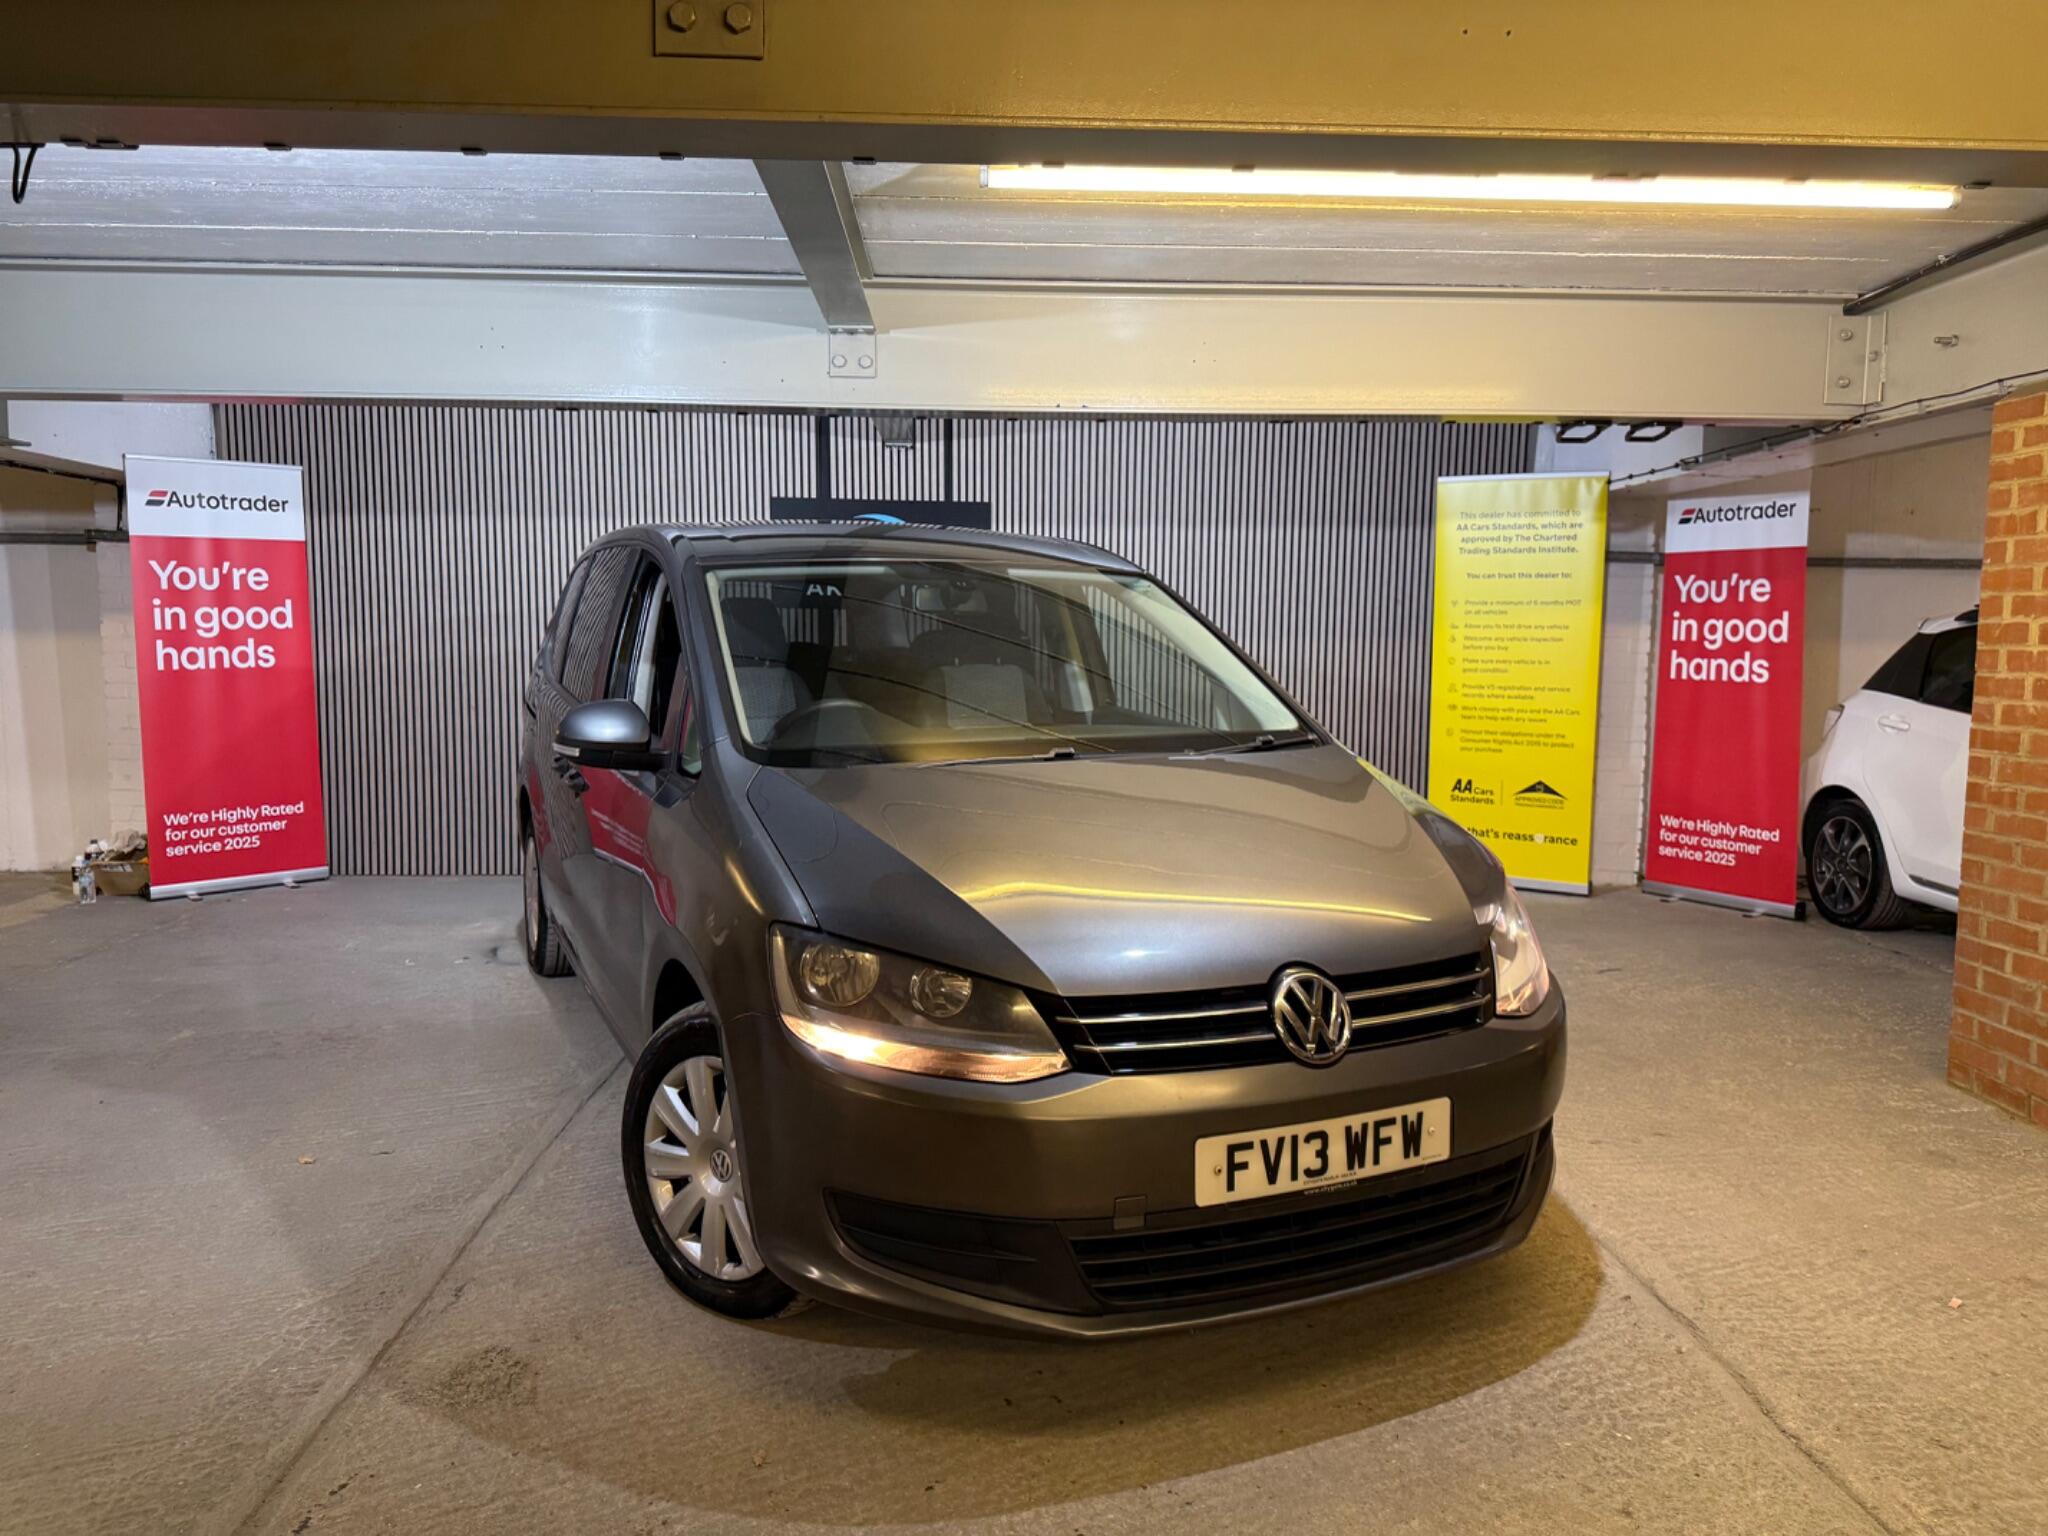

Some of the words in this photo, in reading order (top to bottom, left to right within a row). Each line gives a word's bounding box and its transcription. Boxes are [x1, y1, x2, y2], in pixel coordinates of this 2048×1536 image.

[167, 490, 288, 512] Autotrader
[1524, 509, 1570, 517] committed
[1693, 501, 1796, 524] Autotrader
[1492, 523, 1538, 531] Standards,
[1459, 547, 1490, 555] Trading
[1492, 546, 1536, 554] Standards
[1461, 535, 1500, 544] approved
[1502, 535, 1513, 543] by
[149, 560, 269, 590] You're
[1674, 573, 1772, 603] You're
[152, 598, 187, 631] in
[194, 599, 293, 638] good
[1671, 611, 1697, 642] in
[1703, 611, 1789, 651] good
[156, 638, 276, 671] hands
[1669, 649, 1769, 683] hands
[1451, 778, 1473, 793] AA
[1473, 786, 1494, 795] Cars
[1450, 794, 1494, 805] Standards
[163, 812, 209, 827] We're
[211, 806, 259, 823] Highly
[261, 801, 304, 817] Rated
[165, 829, 188, 842] for
[190, 827, 216, 839] our
[218, 820, 287, 836] customer
[1503, 831, 1578, 846] reassrance
[1660, 814, 1695, 830] We're
[1697, 819, 1737, 838] Highly
[1739, 825, 1780, 842] Rated
[166, 840, 222, 857] service
[224, 835, 260, 851] 2025
[1660, 828, 1678, 843] for
[1678, 834, 1700, 846] our
[1700, 836, 1762, 855] customer
[1659, 845, 1703, 862] service
[1705, 850, 1736, 867] 2025
[1226, 1129, 1329, 1192] FV13
[1344, 1111, 1424, 1171] WFW
